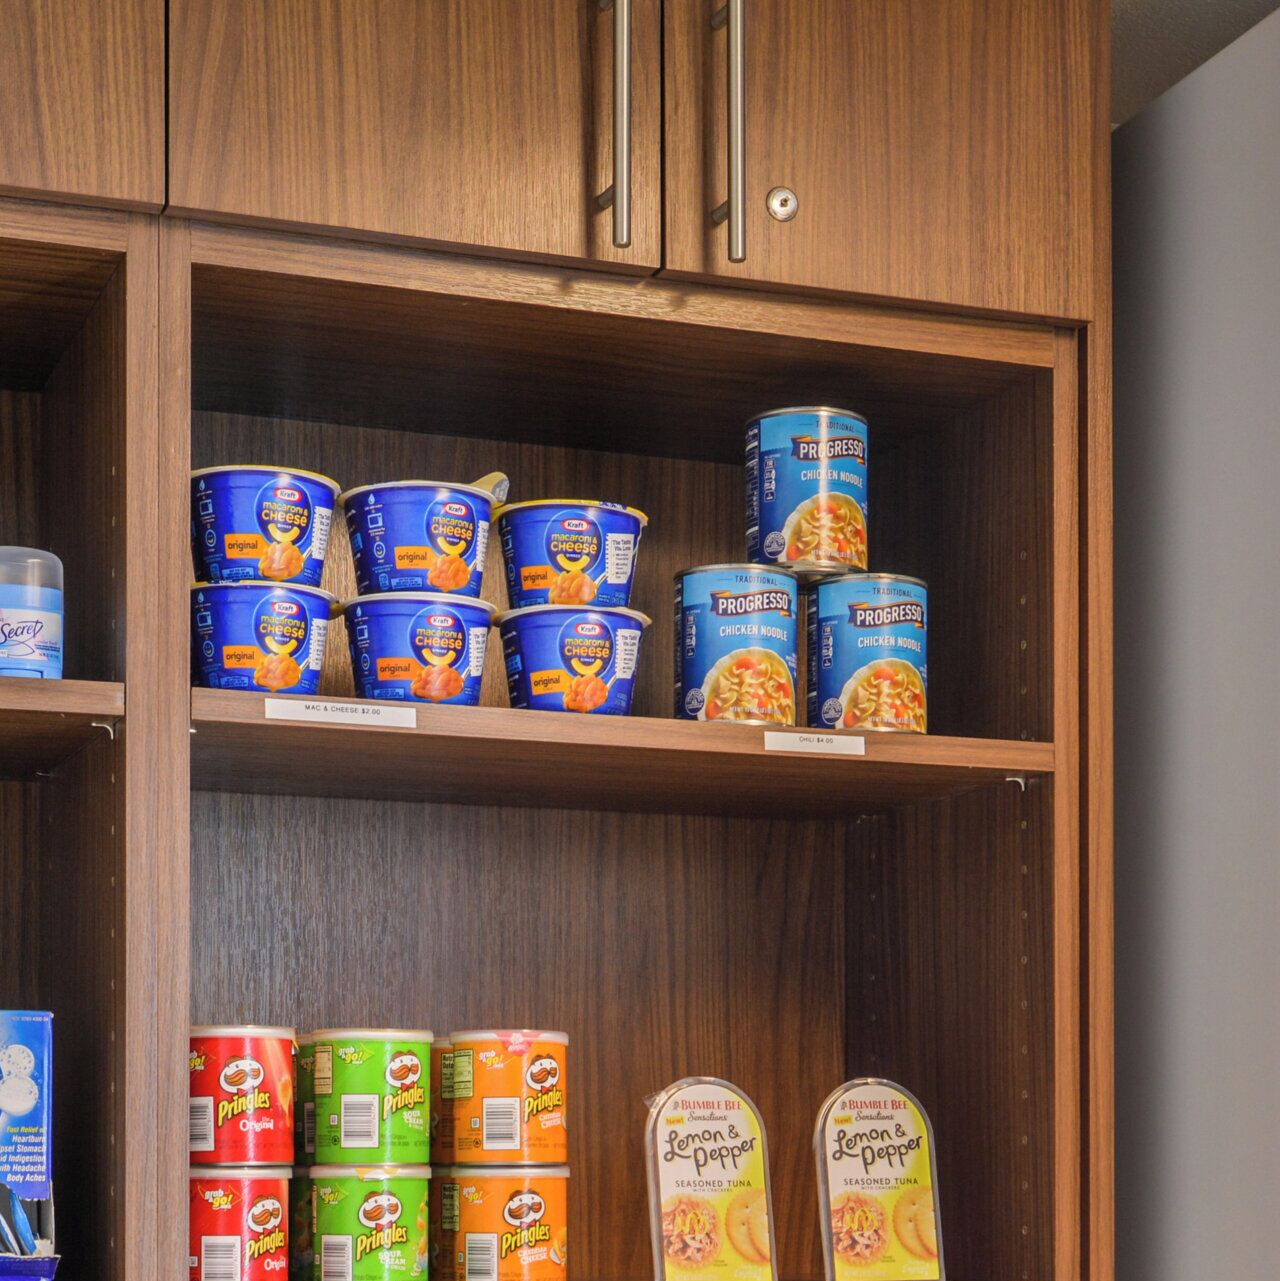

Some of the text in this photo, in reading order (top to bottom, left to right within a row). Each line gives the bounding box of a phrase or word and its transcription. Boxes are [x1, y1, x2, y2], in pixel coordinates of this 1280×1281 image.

[800, 439, 863, 458] PROGRESSO
[801, 470, 863, 488] CHICKEN NOODLE
[551, 534, 592, 542] macaroni
[523, 572, 548, 583] original
[735, 575, 778, 586] TRADITIONAL
[718, 594, 789, 614] PROGRESSO
[856, 605, 922, 625] PROGRESSO
[720, 625, 788, 641] CHICKEN NOODLE
[858, 636, 921, 652] CHICKEN NOODLE
[534, 676, 560, 687] original
[799, 736, 814, 744] CHILI
[217, 1090, 270, 1127] Pringles
[382, 1085, 425, 1122] Pringles
[524, 1090, 563, 1123] Pringles
[681, 1100, 741, 1110] BUMBLE BEE
[848, 1100, 909, 1110] BUMBLE BEE
[239, 1118, 274, 1132] Original
[664, 1124, 740, 1162] Lemon &
[833, 1123, 907, 1161] Lemon &
[7, 1174, 46, 1182] Body Aches
[675, 1180, 724, 1188] SEASONED
[844, 1177, 919, 1186] SEASONED TUNA
[245, 1230, 285, 1263] Pringles
[356, 1224, 408, 1261] Pringles
[501, 1222, 550, 1258] Pringles
